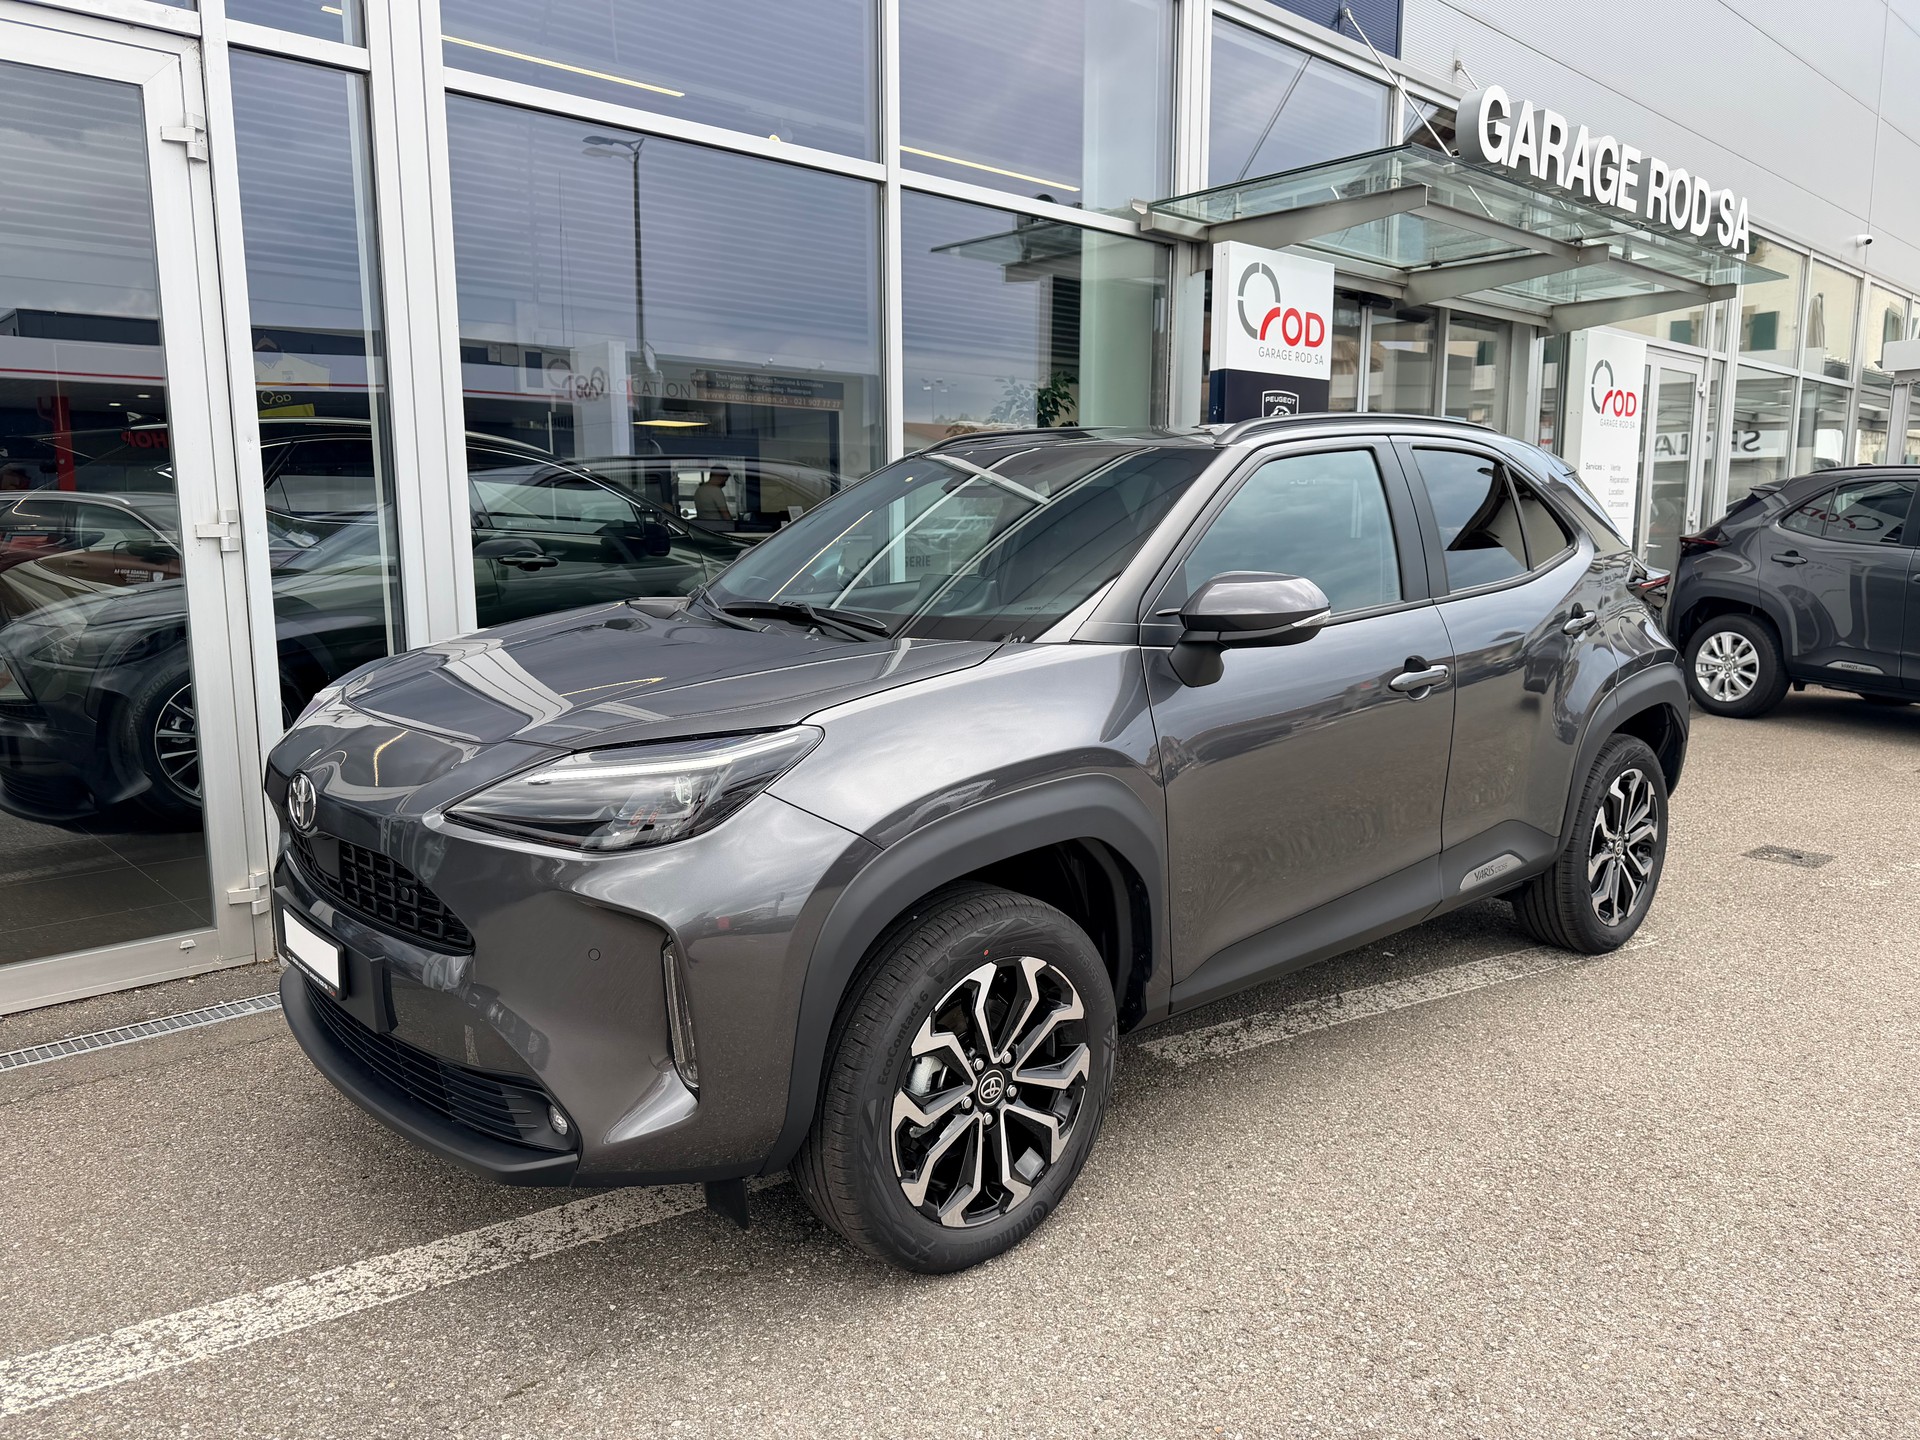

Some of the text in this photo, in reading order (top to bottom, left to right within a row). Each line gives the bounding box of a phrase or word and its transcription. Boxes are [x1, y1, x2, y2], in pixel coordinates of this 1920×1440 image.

[1478, 85, 1749, 254] GARAGE ROD SA
[1258, 346, 1324, 366] GARAGE ROD SA
[1265, 395, 1296, 405] PEUGEOT
[1600, 418, 1635, 430] GARAGE ROD SA
[877, 990, 929, 1086] EcoContact 6
